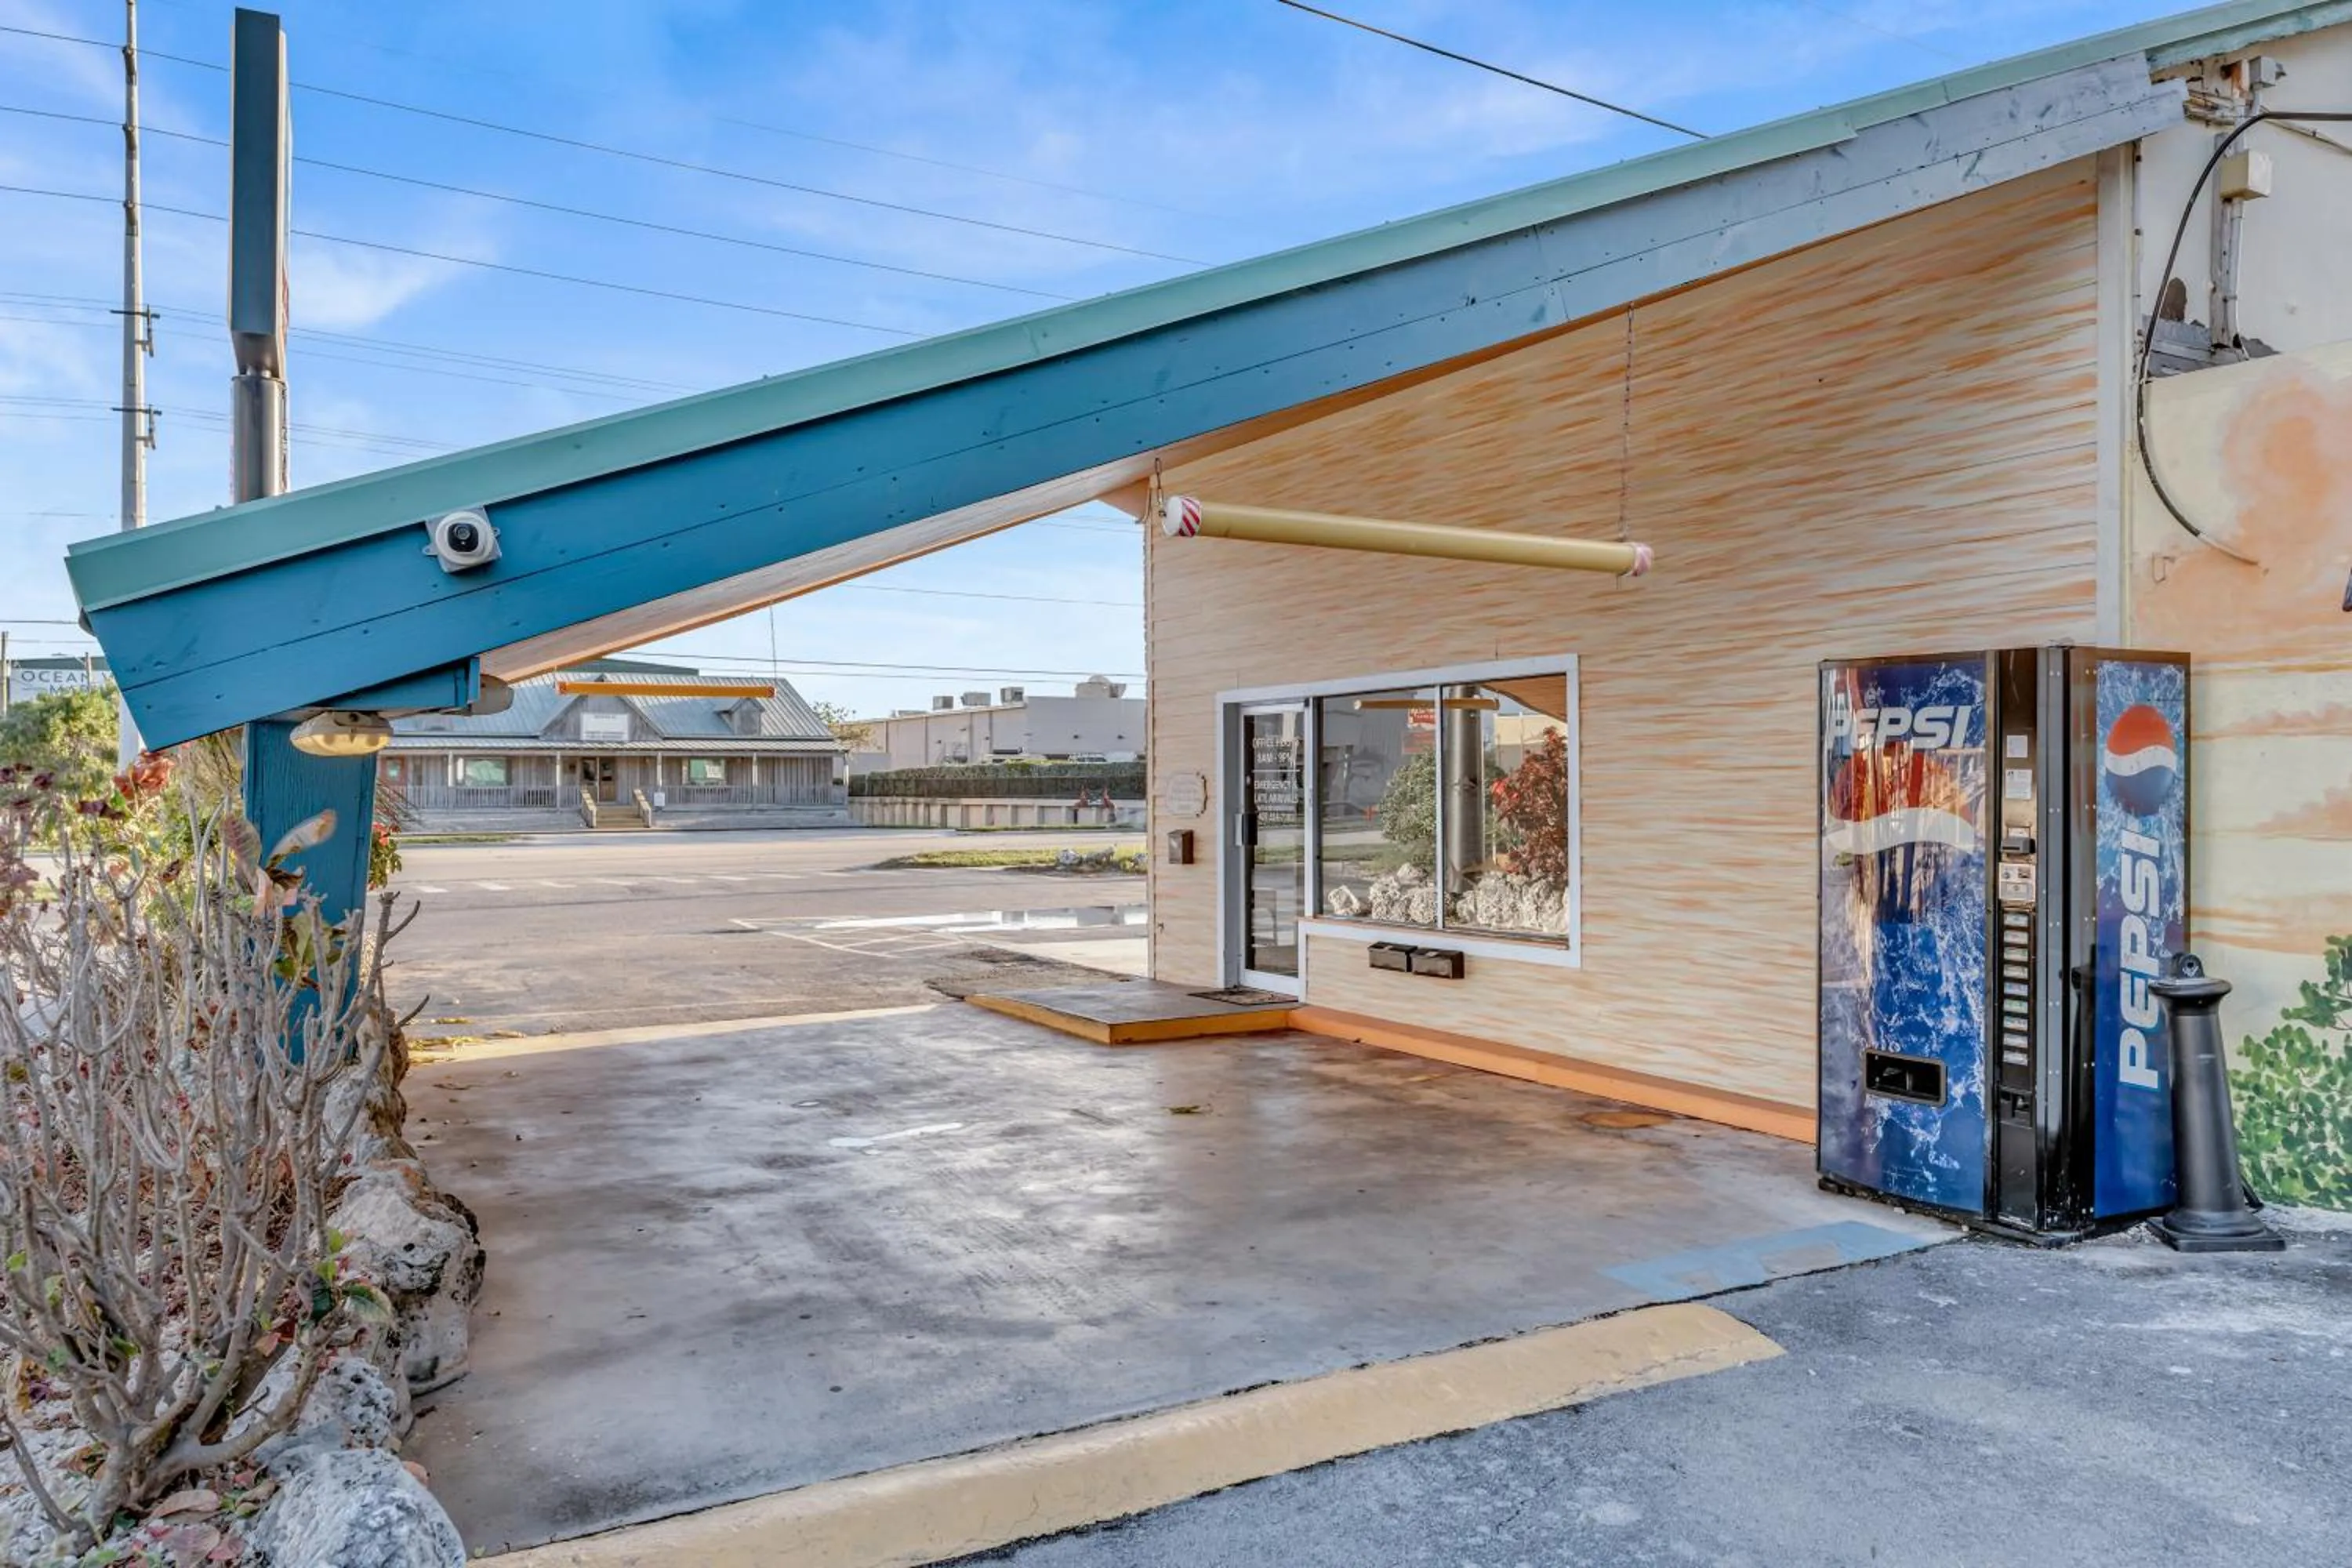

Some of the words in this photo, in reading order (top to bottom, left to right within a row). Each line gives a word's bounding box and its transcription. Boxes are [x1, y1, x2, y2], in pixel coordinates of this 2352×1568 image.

[21, 670, 89, 683] OCEAN
[1825, 706, 1972, 750] PEPSI
[2119, 829, 2160, 1089] PEPSI
